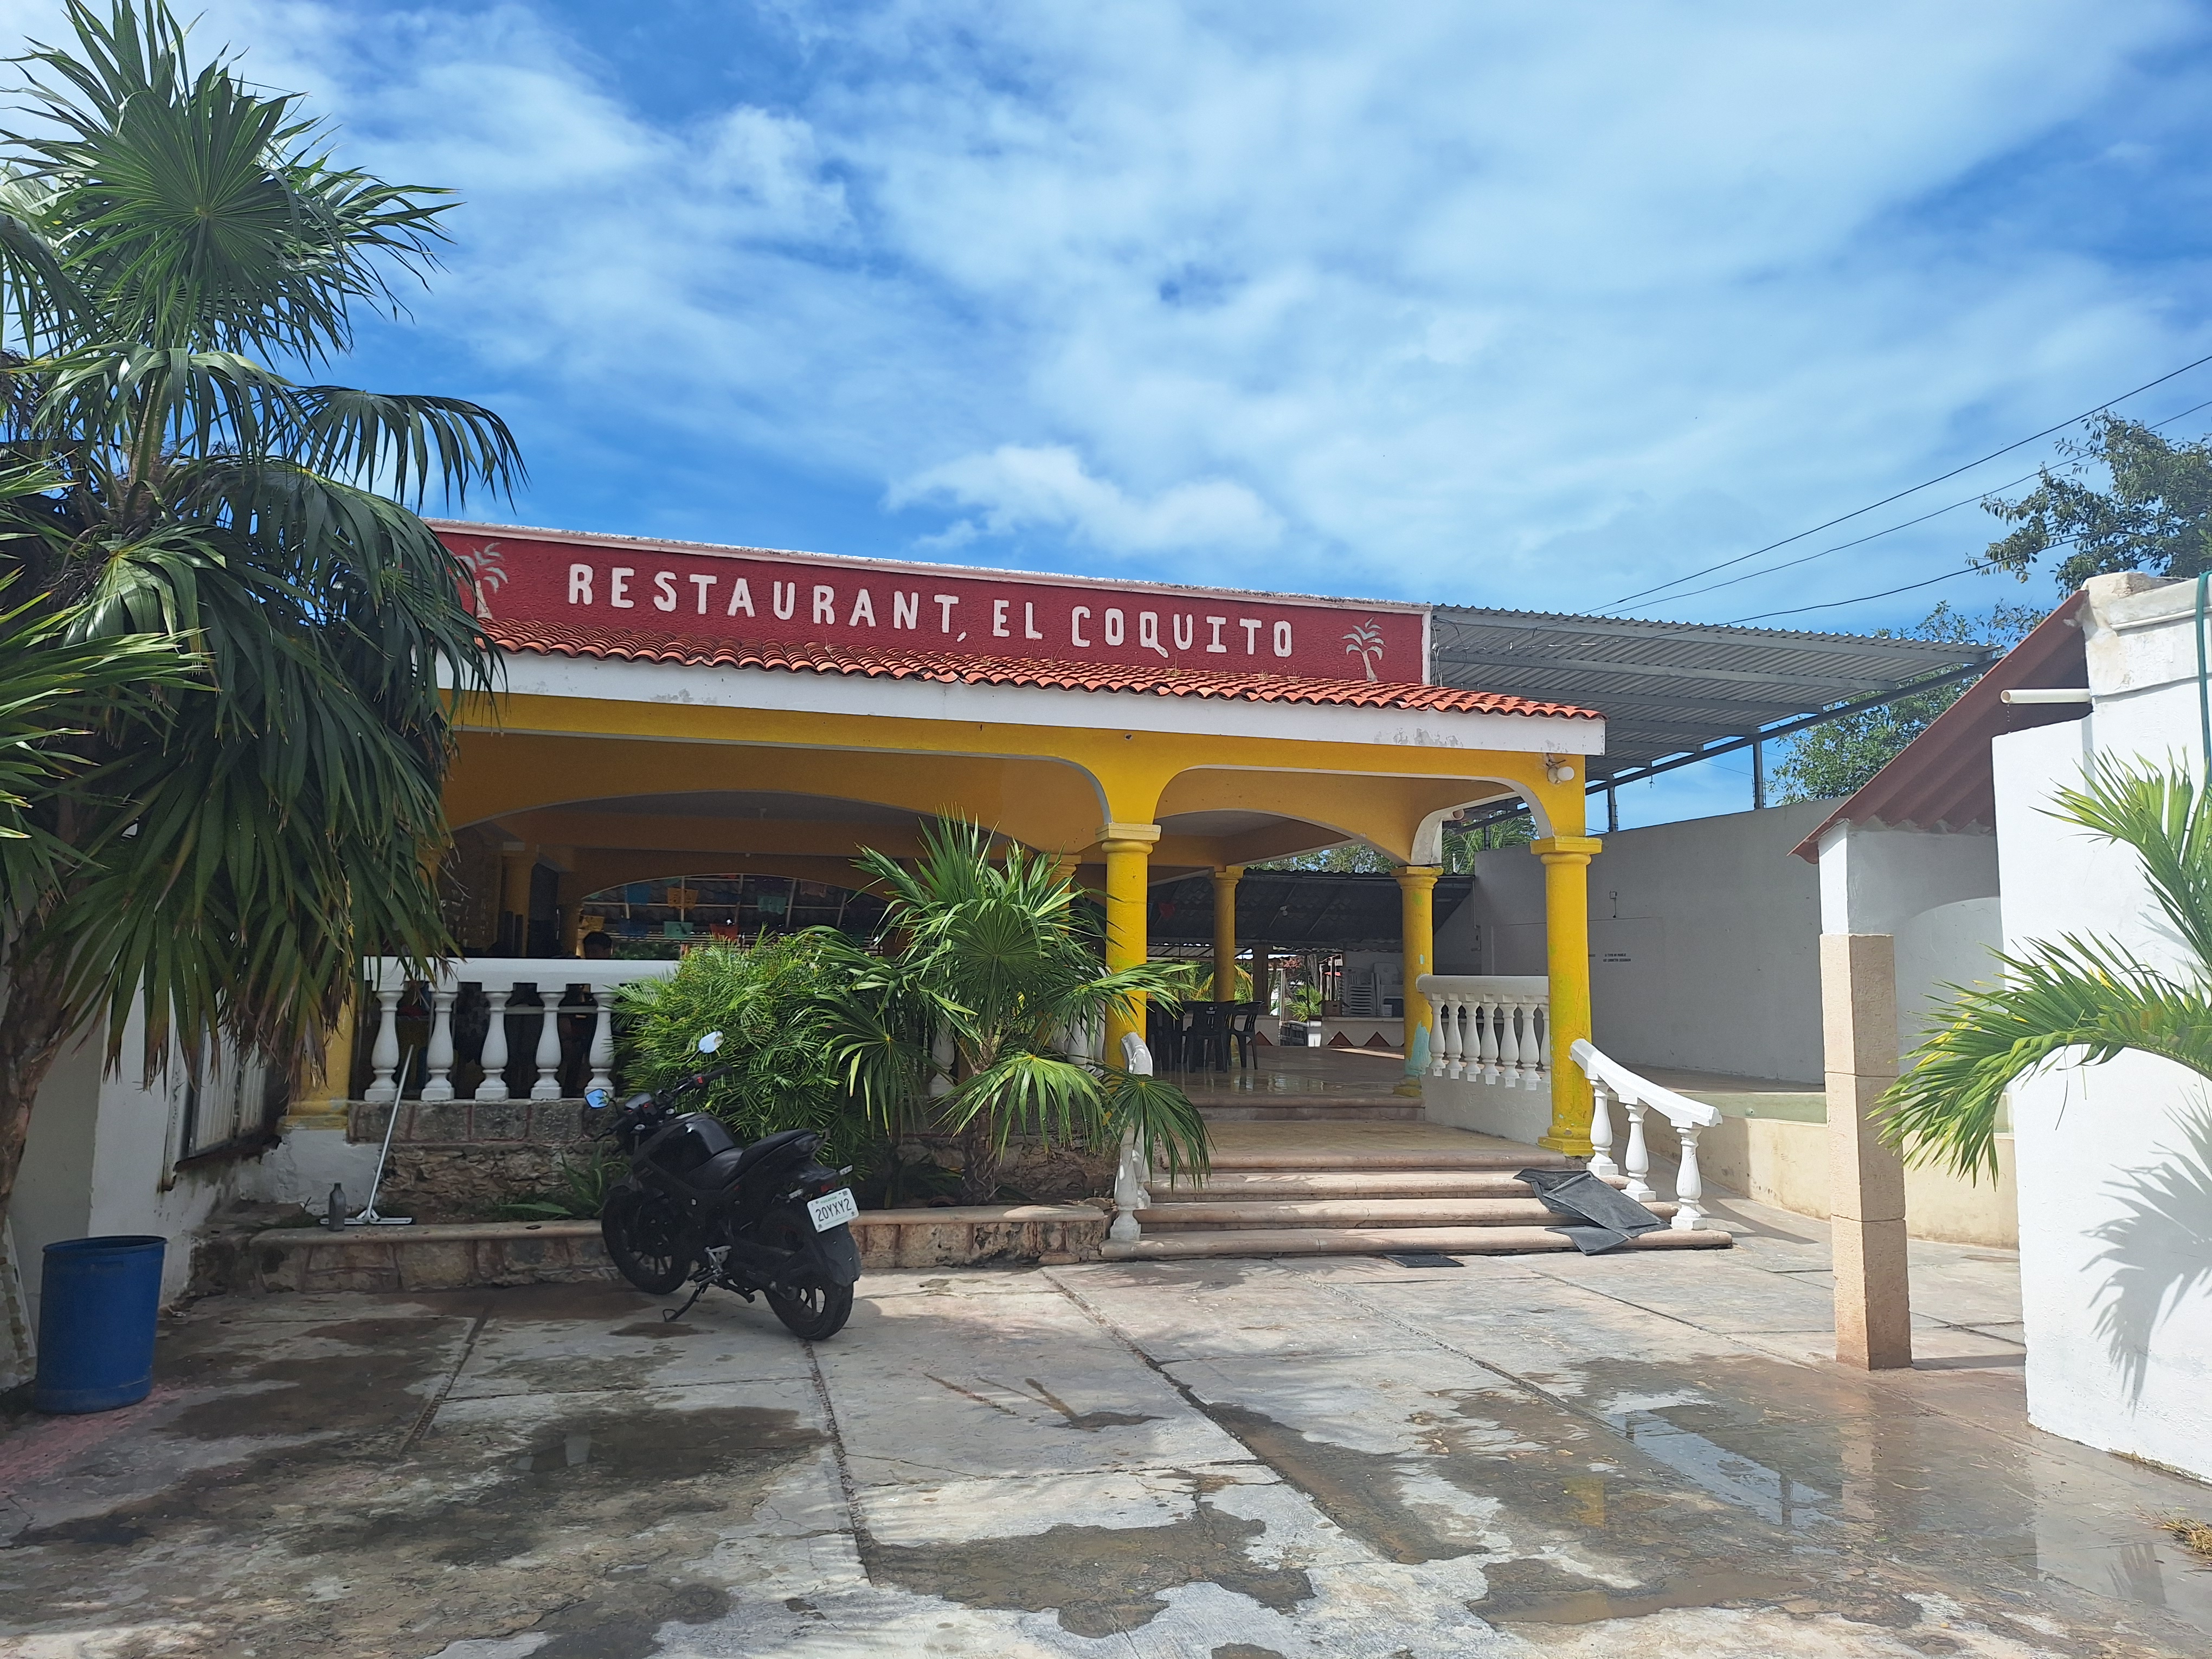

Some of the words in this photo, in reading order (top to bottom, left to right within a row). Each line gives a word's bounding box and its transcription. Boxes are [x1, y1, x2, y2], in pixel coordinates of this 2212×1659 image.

[992, 599, 1043, 640] EL
[1071, 606, 1293, 658] COQUITO
[815, 1198, 852, 1222] 20YXY2
